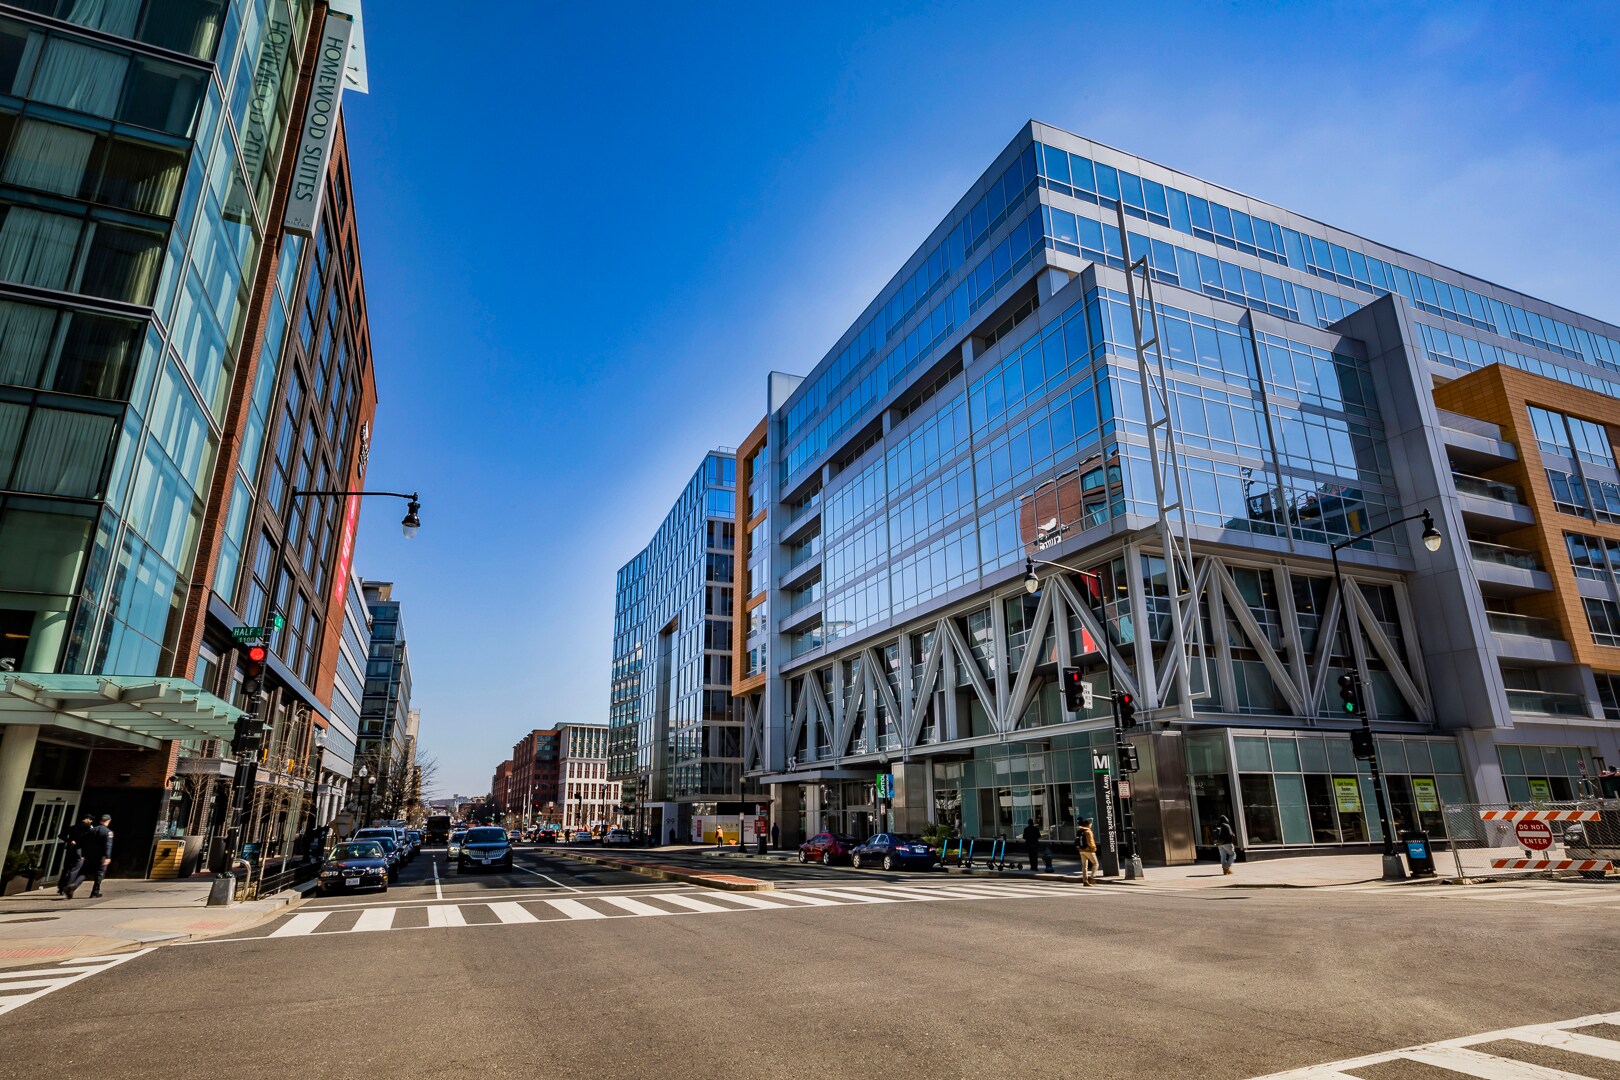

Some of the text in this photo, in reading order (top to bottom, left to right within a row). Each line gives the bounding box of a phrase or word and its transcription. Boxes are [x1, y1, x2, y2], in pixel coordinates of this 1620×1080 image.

[295, 36, 344, 203] HOMEWOOD SUITES
[233, 628, 255, 636] HALF
[787, 756, 797, 772] 55
[1093, 755, 1109, 769] M
[1104, 790, 1114, 830] Yard-Ballpark
